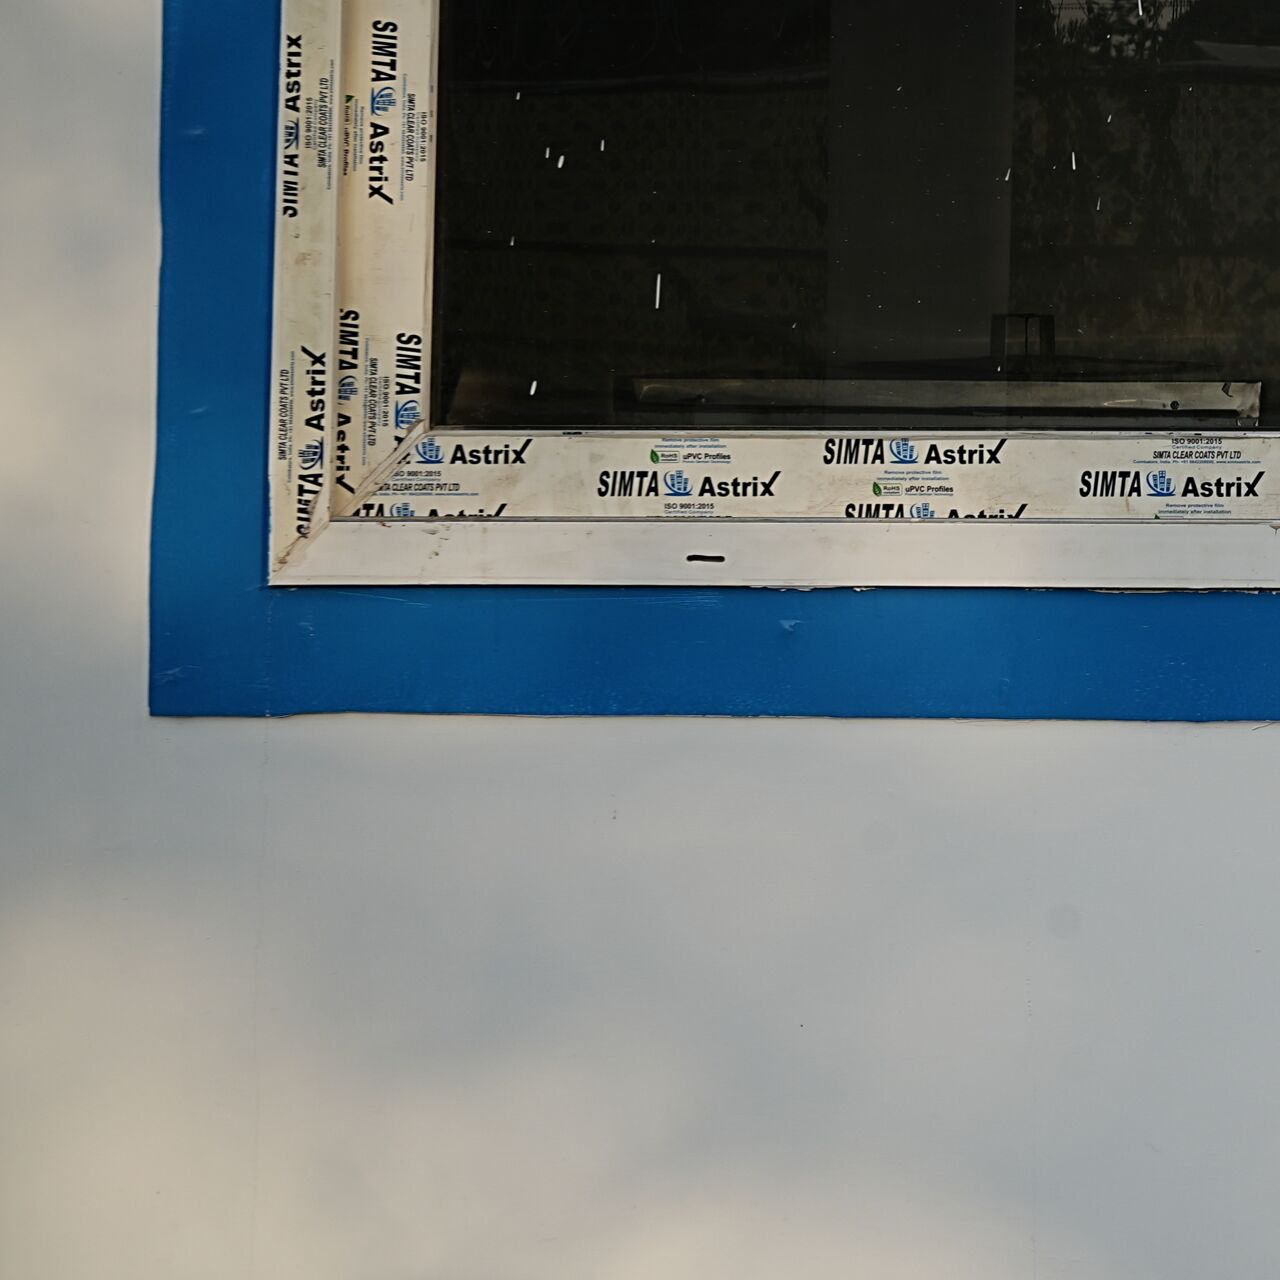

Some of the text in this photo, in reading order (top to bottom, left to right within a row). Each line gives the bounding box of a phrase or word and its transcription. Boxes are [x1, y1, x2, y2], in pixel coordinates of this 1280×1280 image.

[371, 21, 397, 81] SIMTA
[395, 333, 422, 395] SIMTA
[823, 438, 884, 464] SIMTA
[598, 471, 658, 497] SIMTA
[1080, 471, 1141, 497] SIMTA
